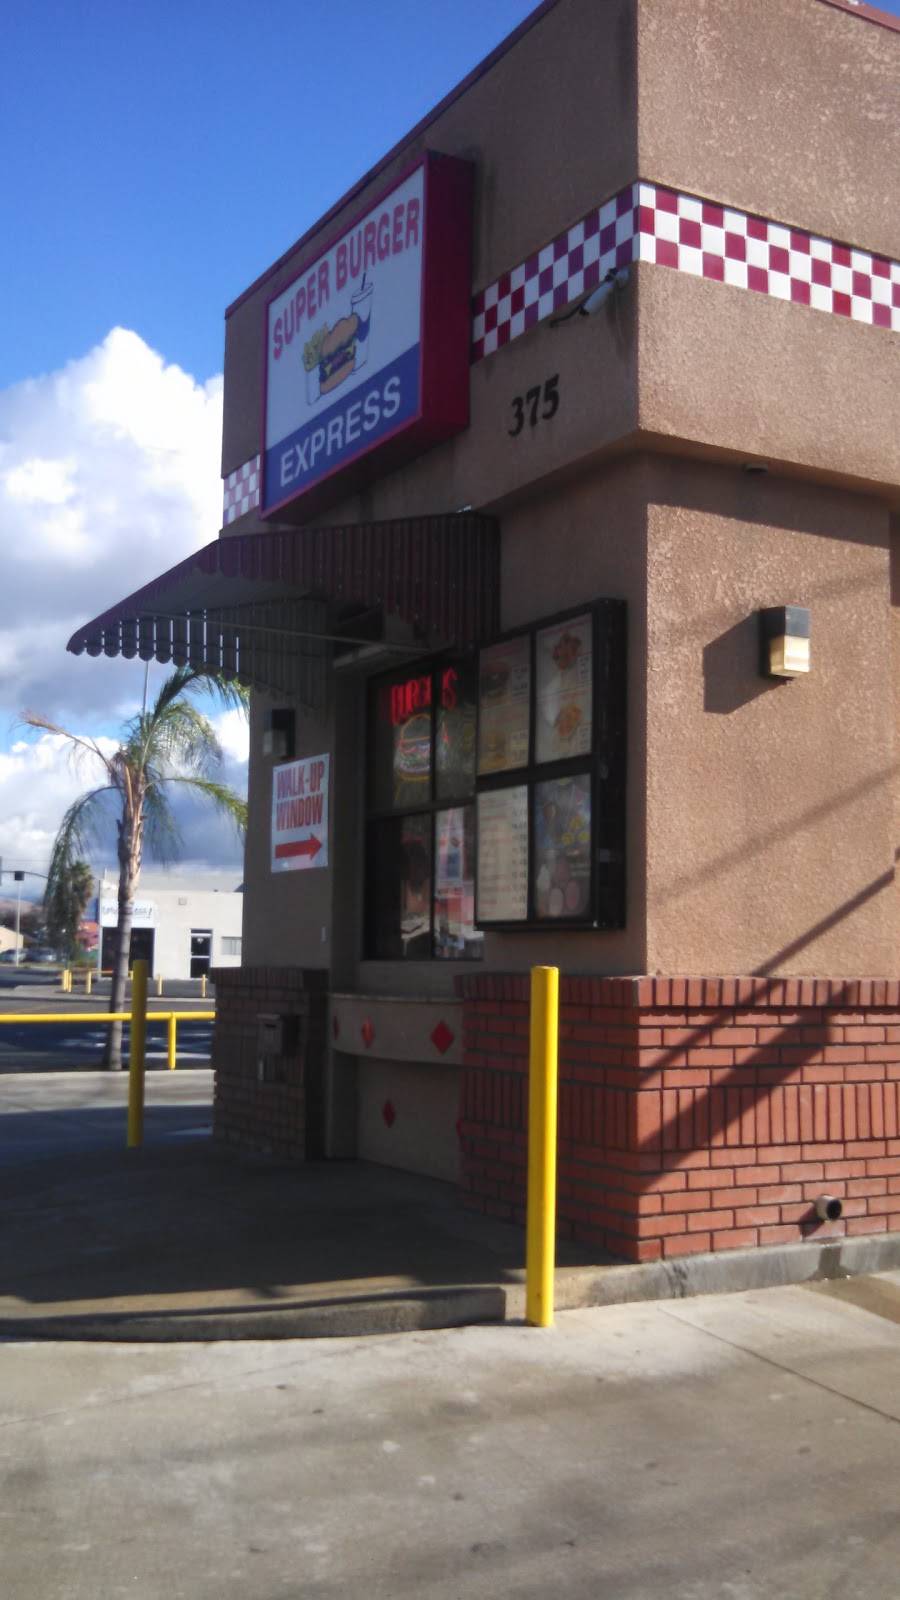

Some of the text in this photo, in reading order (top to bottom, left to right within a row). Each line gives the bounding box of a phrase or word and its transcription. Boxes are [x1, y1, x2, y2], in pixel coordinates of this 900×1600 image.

[273, 198, 420, 360] SUPER BURGER
[280, 376, 401, 487] EXPRESS
[508, 373, 560, 437] 375
[276, 793, 324, 831] WINDOW
[277, 760, 325, 800] WALK-UP
